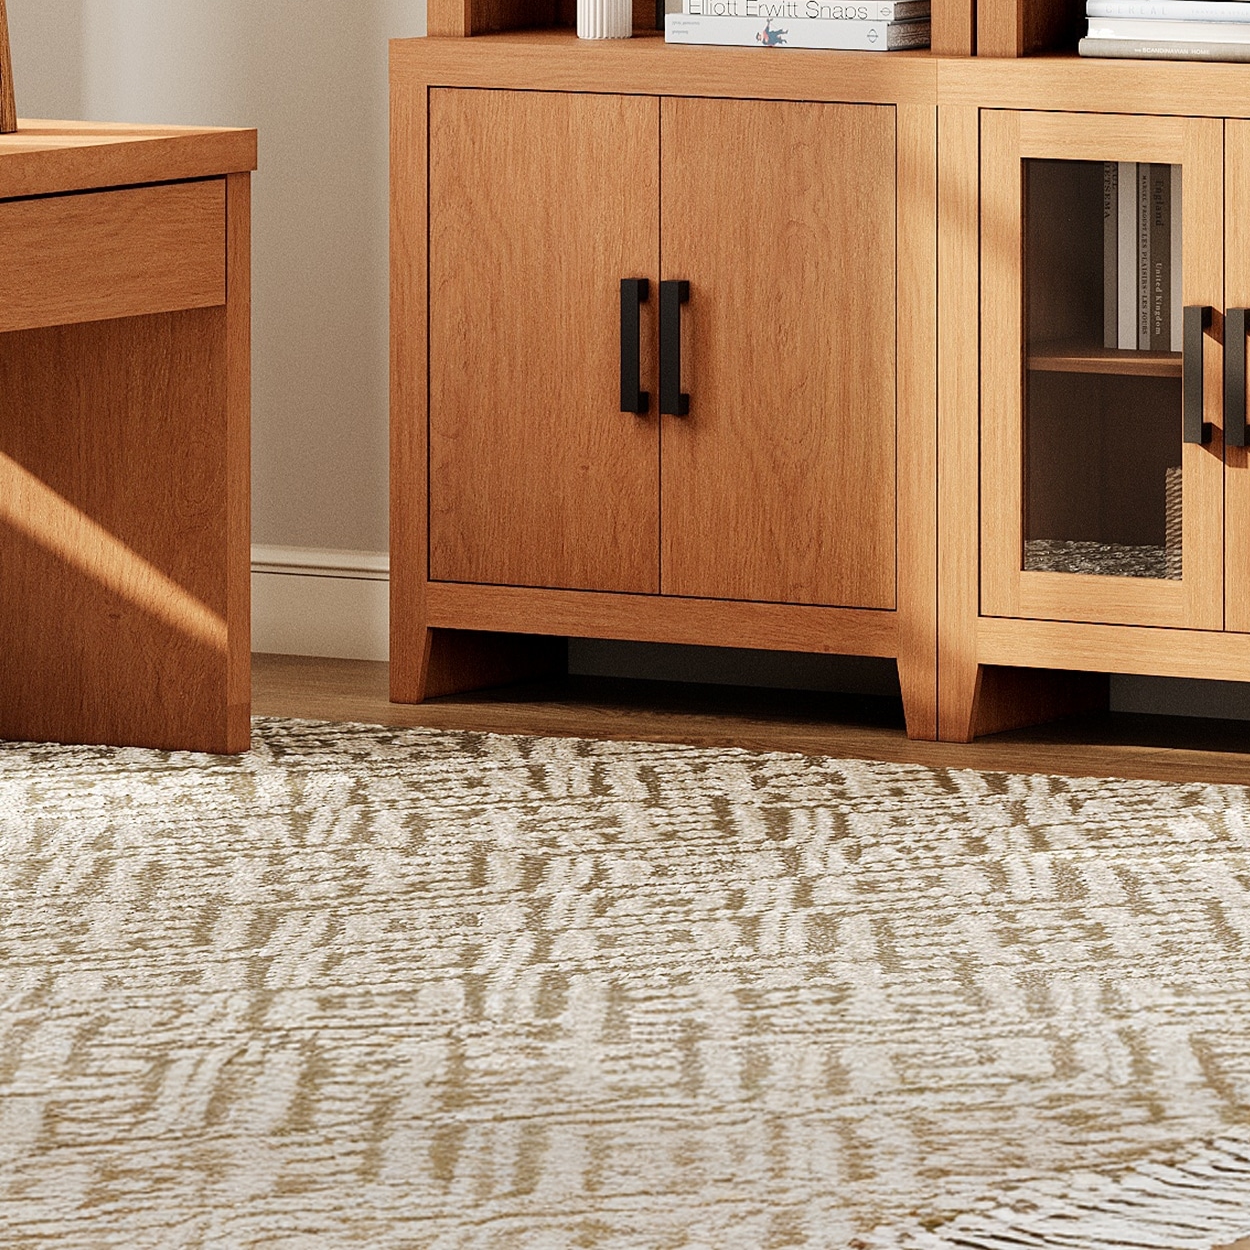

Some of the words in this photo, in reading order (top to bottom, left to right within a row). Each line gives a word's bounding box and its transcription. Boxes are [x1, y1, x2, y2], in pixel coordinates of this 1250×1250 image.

[745, 0, 798, 17] Erwitt
[805, 0, 868, 20] Snaps
[1104, 164, 1112, 219] IETSEMA
[1153, 180, 1165, 227] England
[1155, 262, 1163, 293] United
[1153, 295, 1163, 335] Kingdom
